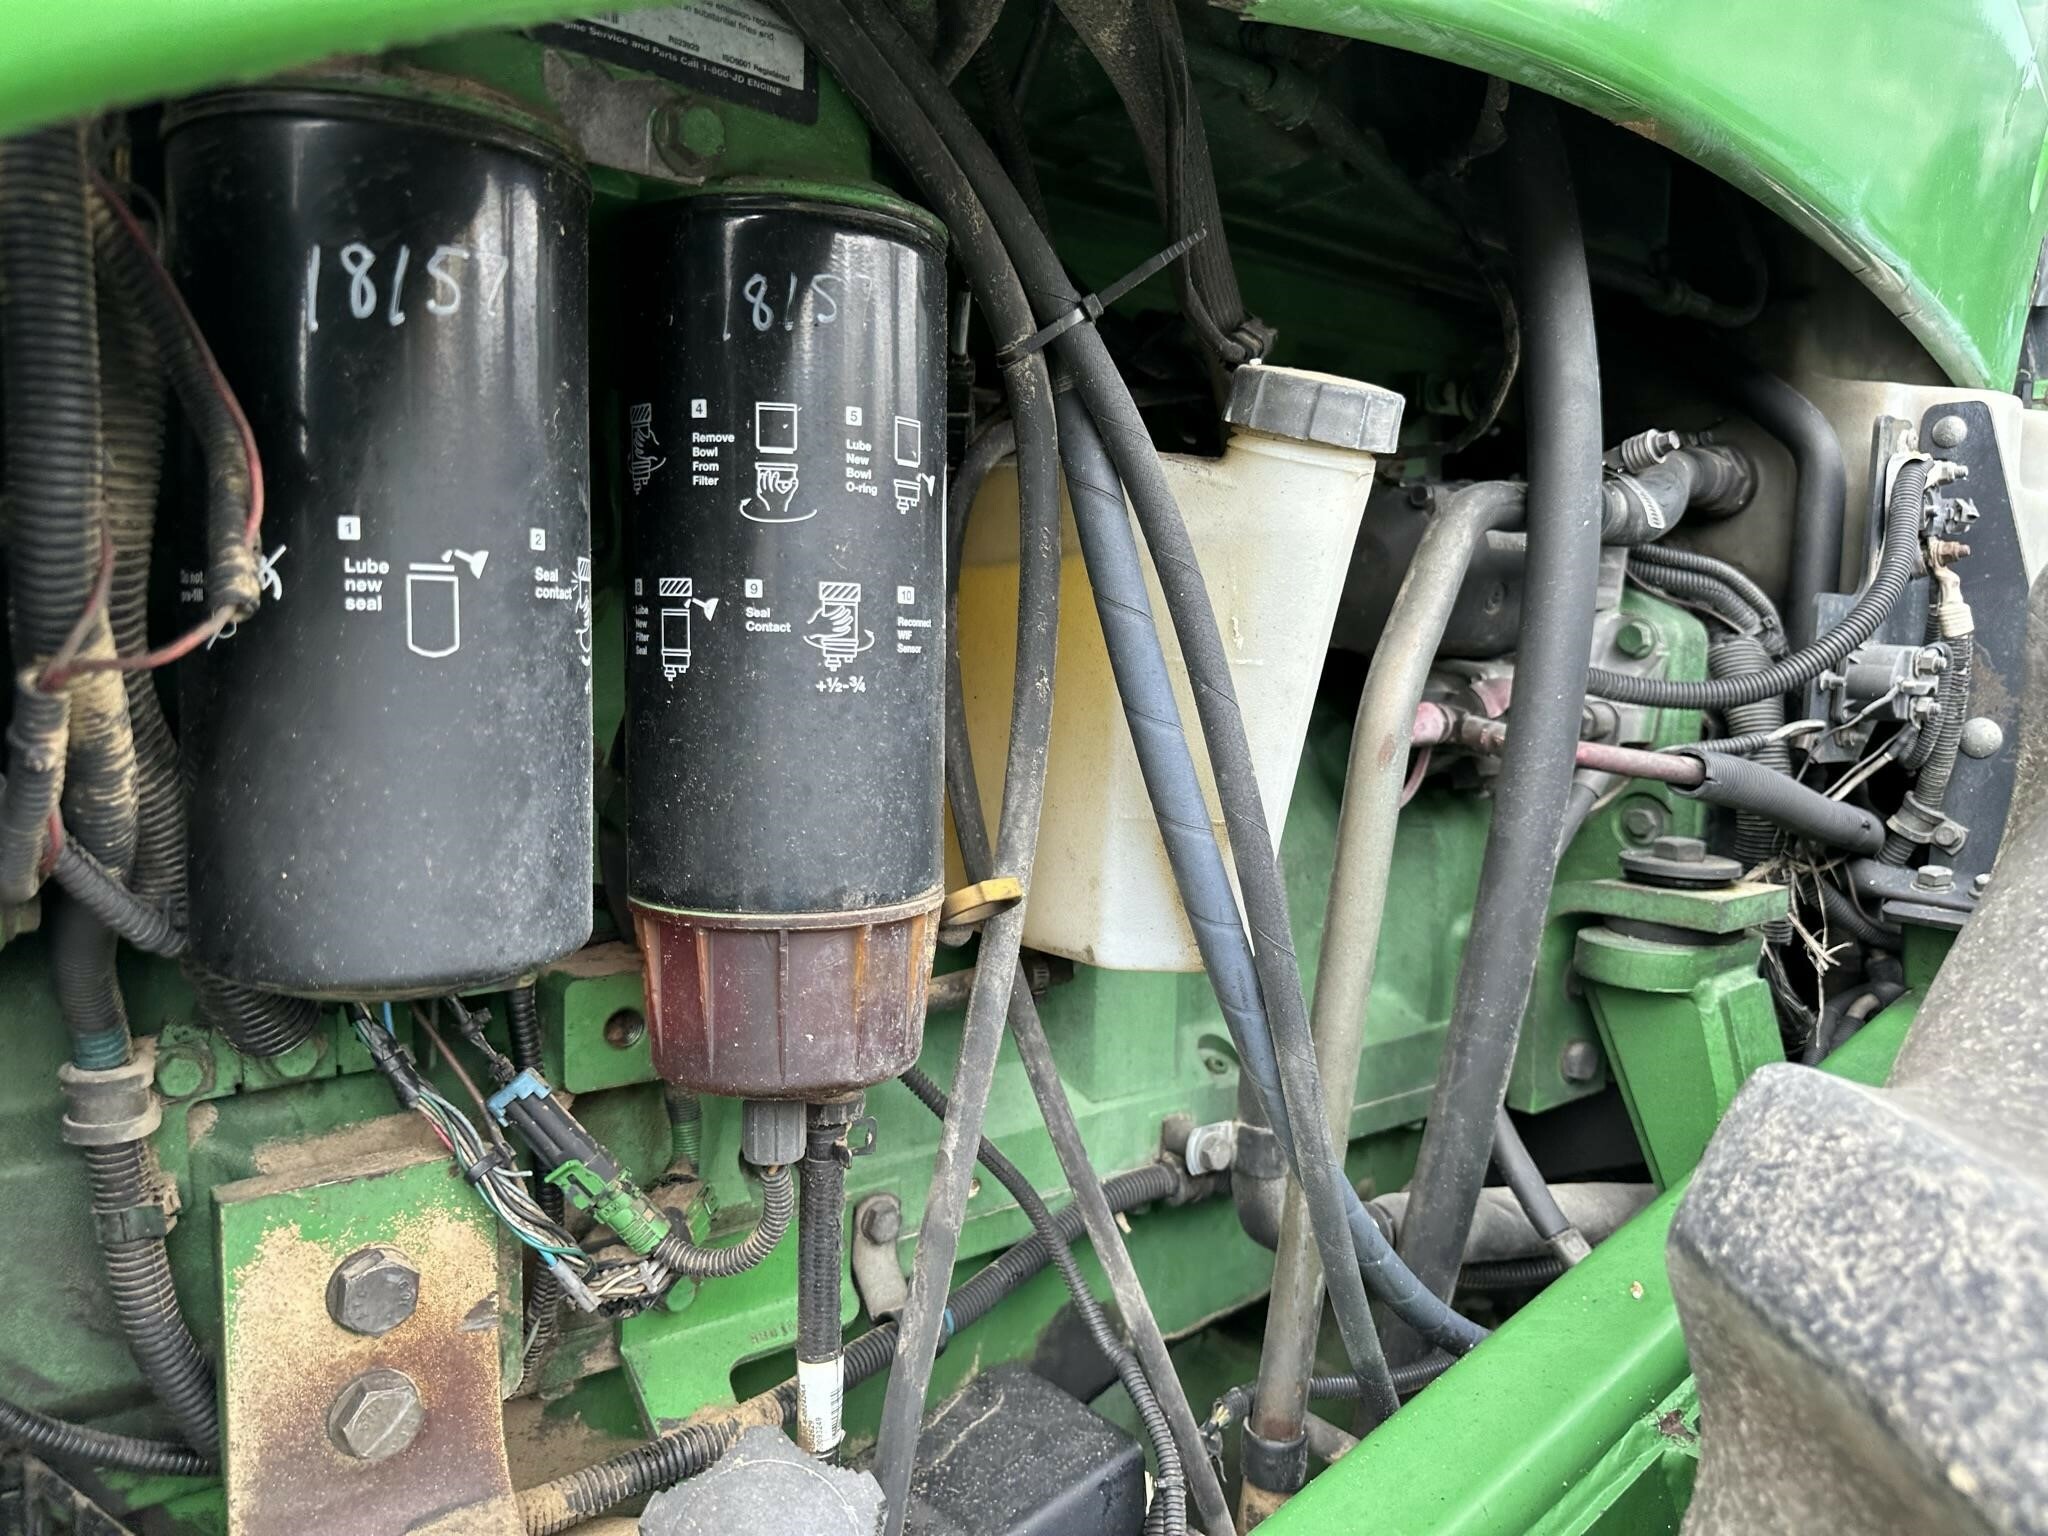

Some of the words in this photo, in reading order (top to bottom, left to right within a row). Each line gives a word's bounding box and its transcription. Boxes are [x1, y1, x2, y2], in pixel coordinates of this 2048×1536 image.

[589, 26, 628, 45] Service
[632, 40, 650, 52] and
[652, 46, 678, 62] Parts
[680, 56, 700, 70] Call
[747, 78, 783, 97] ENGINE
[308, 243, 508, 333] 18157
[692, 432, 735, 443] Remove
[692, 446, 718, 458] Bowl
[846, 440, 872, 452] Lube
[846, 454, 869, 466] New
[692, 461, 719, 472] From
[846, 468, 872, 480] Bowl
[692, 475, 719, 486] Filter
[846, 482, 878, 496] O-ring
[344, 558, 389, 575] Lube
[535, 568, 558, 582] Seal
[344, 580, 382, 593] new
[535, 585, 573, 601] contact
[345, 596, 382, 612] seal
[746, 607, 771, 618] Seal
[746, 622, 791, 633] Contact
[897, 616, 932, 628] Reconnect
[897, 642, 922, 654] Sensor
